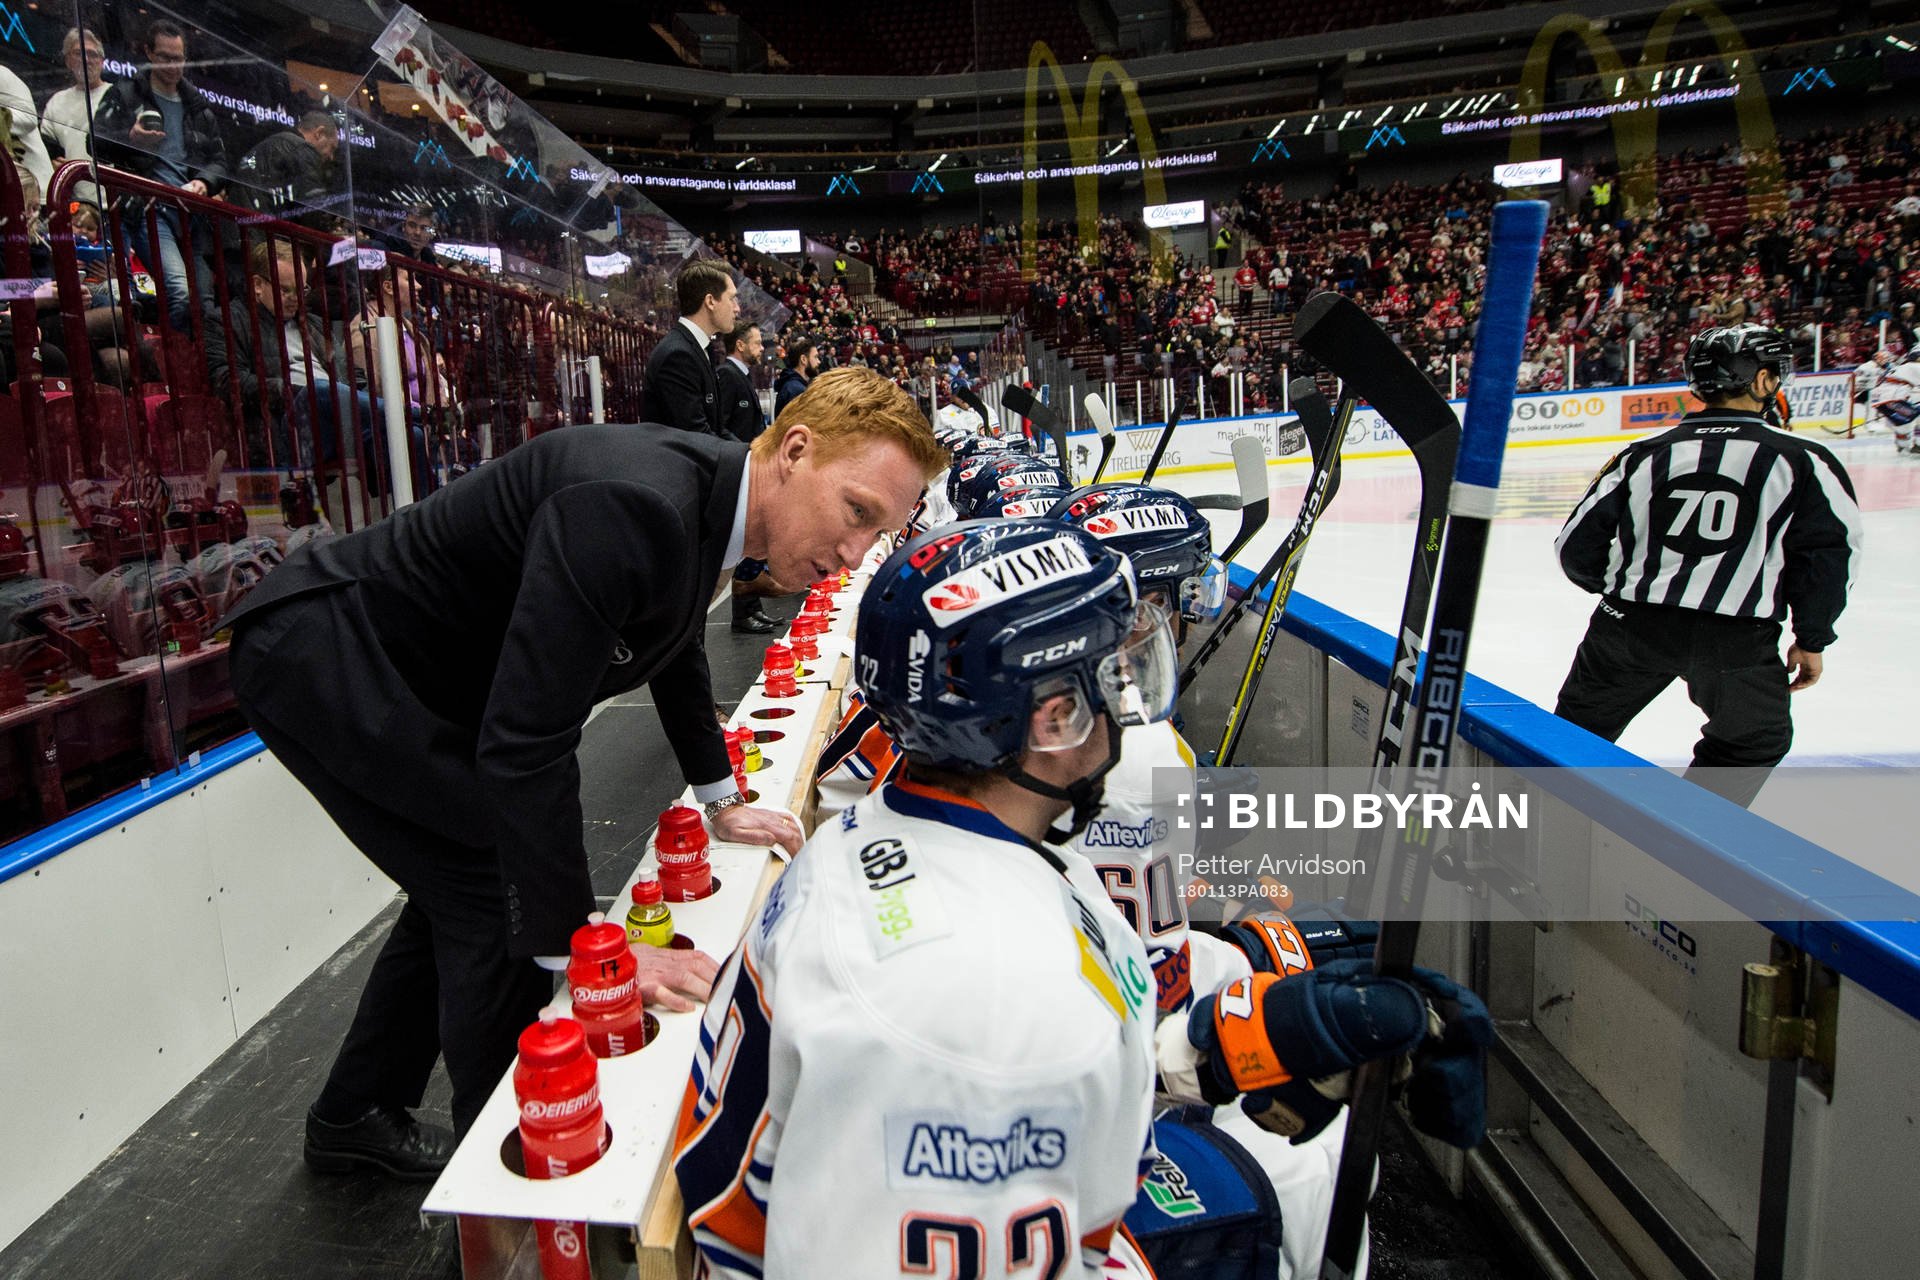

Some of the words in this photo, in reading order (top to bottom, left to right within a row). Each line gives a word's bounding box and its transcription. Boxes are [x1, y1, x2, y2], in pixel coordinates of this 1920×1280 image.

[198, 87, 295, 127] nsvarstagande
[1441, 117, 1499, 134] Säkerhet
[1502, 115, 1528, 127] och
[1530, 100, 1639, 124] ansvarstagande
[570, 168, 620, 183] Säkeet
[622, 173, 643, 185] och
[645, 176, 726, 190] ansvarstagande
[733, 178, 796, 191] världsklass!
[974, 170, 1025, 184] Säkerhet
[1026, 167, 1048, 180] och
[1050, 160, 1139, 177] ansvarstagande
[1148, 151, 1218, 169] världsklass!
[1820, 401, 1844, 415] AB
[1694, 426, 1741, 434] CCM
[1112, 451, 1181, 473] TRELLERG
[1020, 473, 1059, 484] VISMA
[1121, 507, 1185, 529] VISMA
[1666, 489, 1739, 541] 70
[981, 541, 1084, 592] VISMA
[1140, 564, 1180, 578] CCM
[1021, 636, 1087, 668] CCM
[1084, 817, 1169, 848] Atteviks
[661, 851, 698, 864] ENERVIT
[860, 838, 915, 891] GBJ
[601, 960, 619, 978] 17
[591, 978, 634, 1002] ENERVIT
[546, 1085, 600, 1118] ENERVIT
[903, 1116, 1067, 1184] Atteviks
